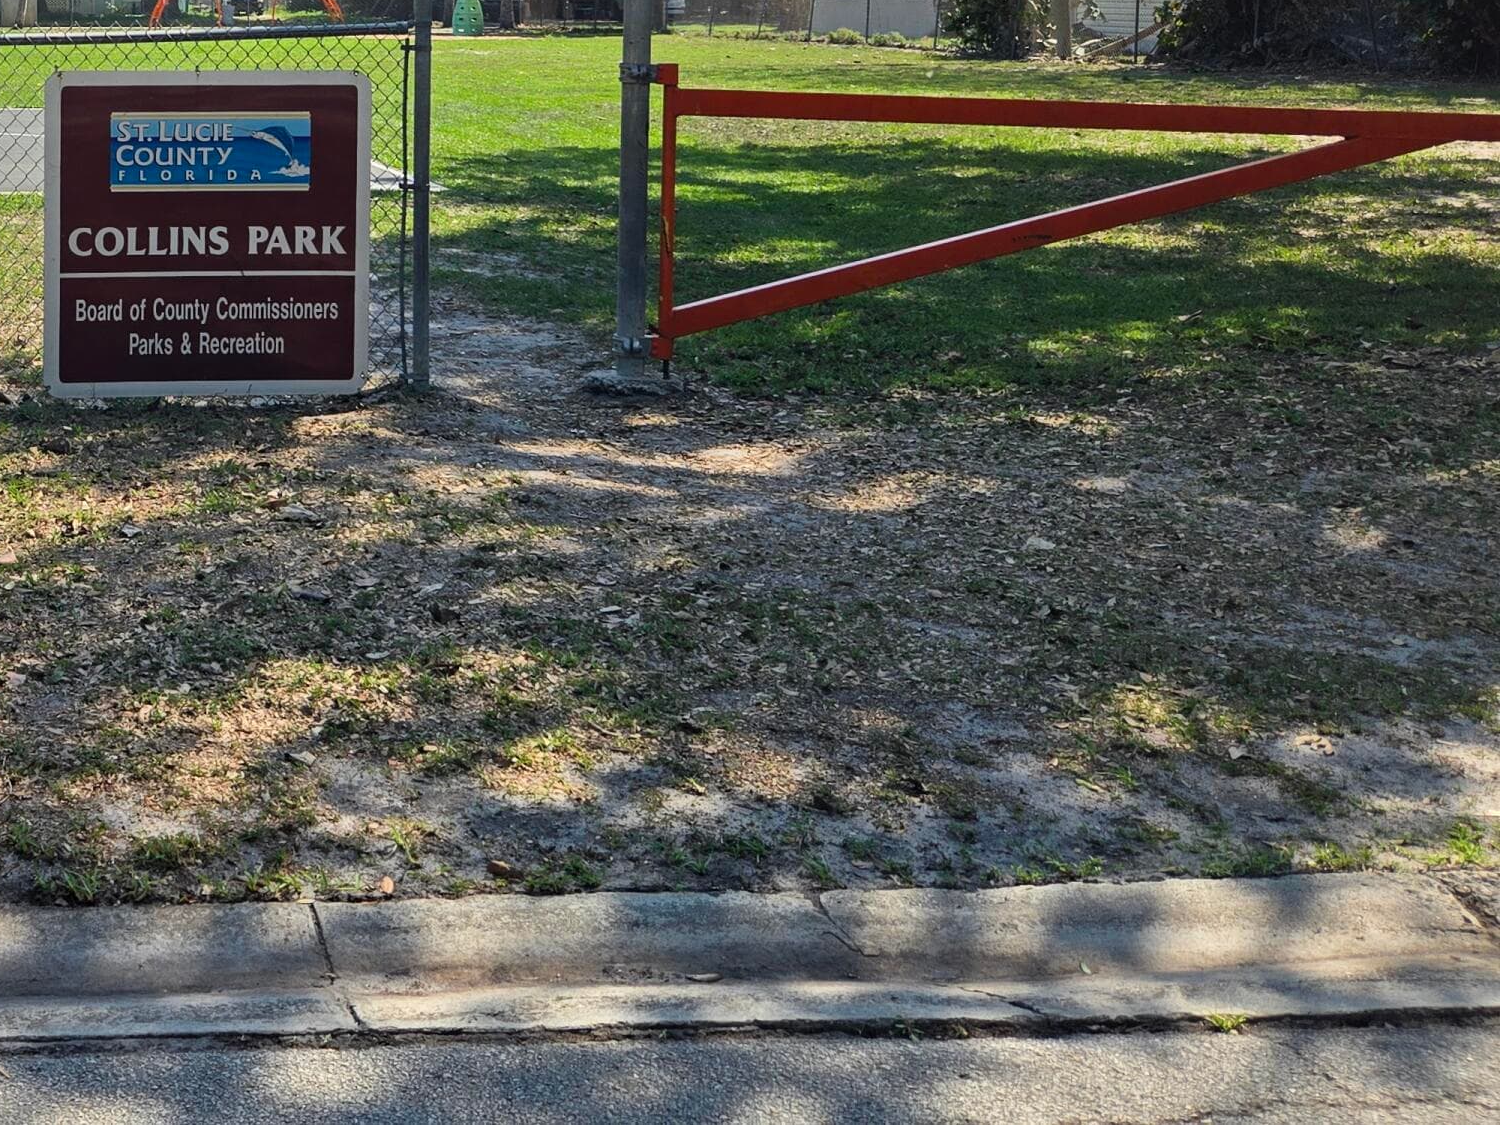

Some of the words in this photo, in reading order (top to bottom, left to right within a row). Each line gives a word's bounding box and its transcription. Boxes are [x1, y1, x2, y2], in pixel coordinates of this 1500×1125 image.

[115, 121, 153, 142] ST.
[158, 120, 234, 142] LUCIE
[115, 145, 233, 166] COUNTY
[118, 169, 262, 181] FLORIDA
[68, 226, 229, 257] COLLINS
[247, 225, 347, 255] PARK
[75, 299, 123, 322] Board
[130, 299, 146, 321] of
[153, 298, 210, 325] County
[216, 296, 339, 320] Commissioners
[129, 332, 173, 355] Parks
[180, 332, 192, 354] &
[199, 331, 285, 354] Recreation
